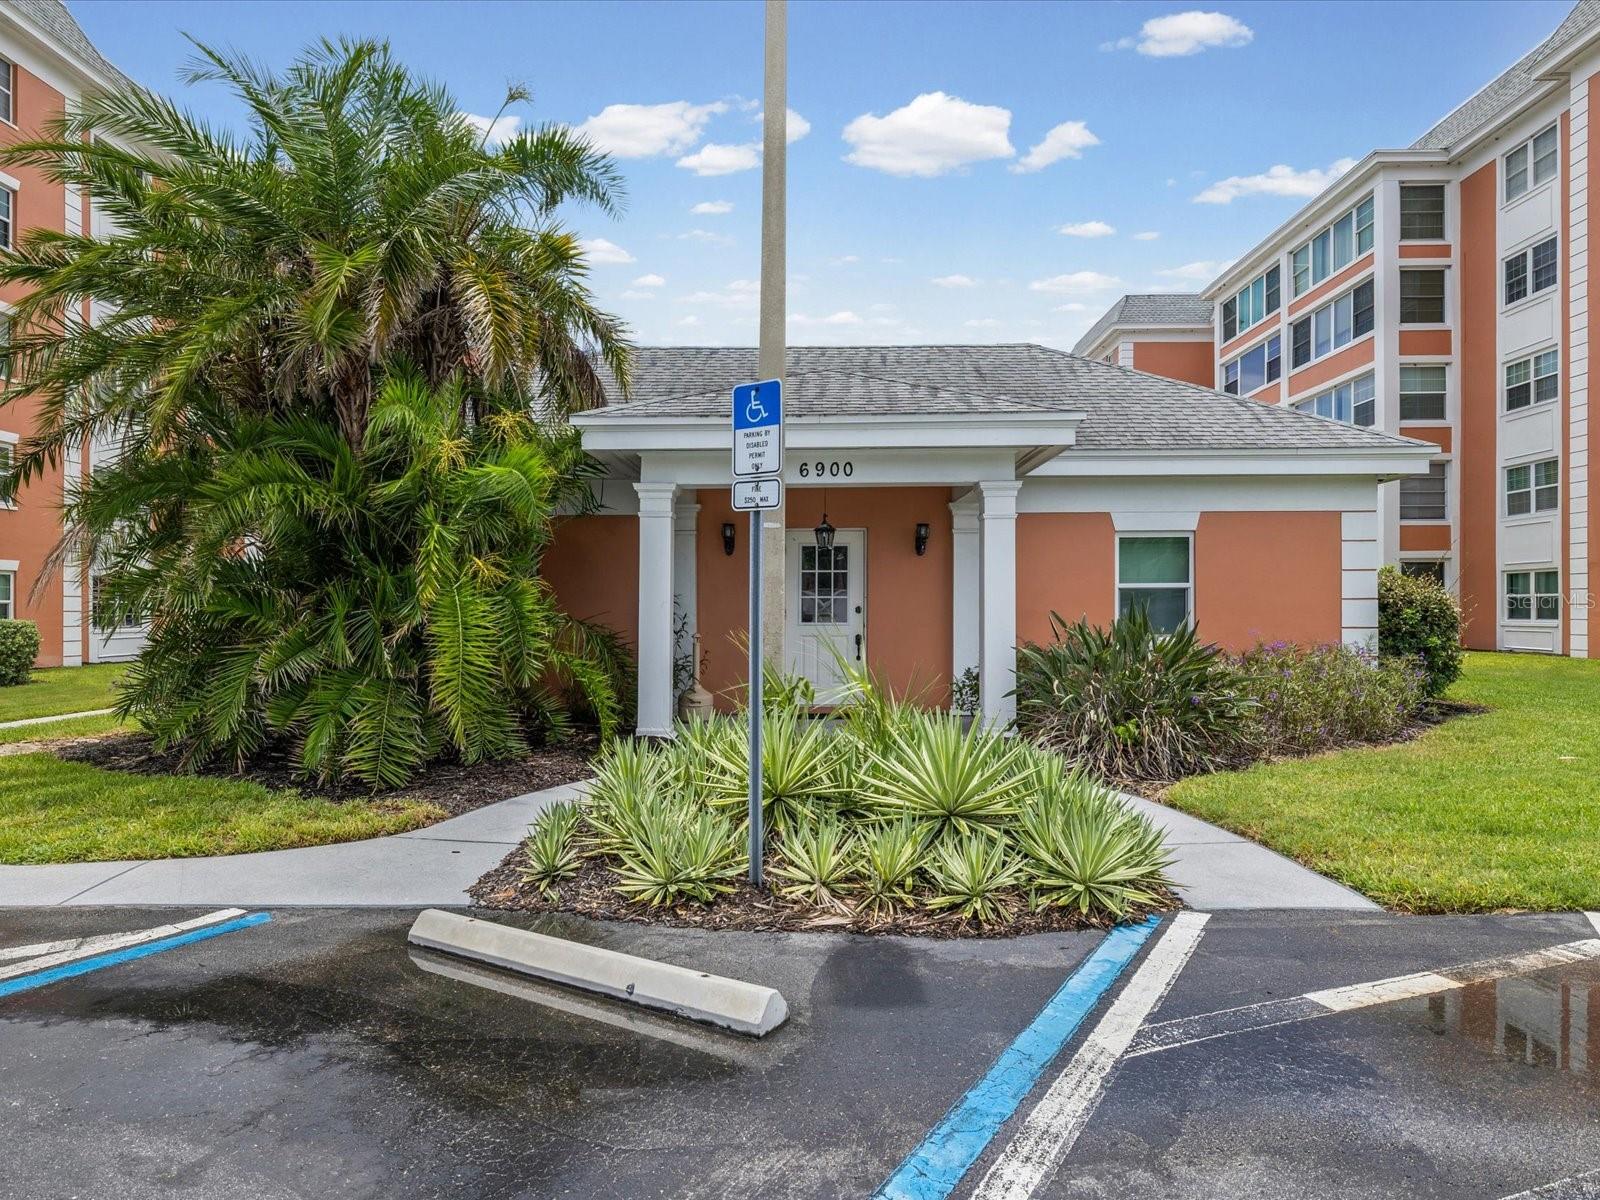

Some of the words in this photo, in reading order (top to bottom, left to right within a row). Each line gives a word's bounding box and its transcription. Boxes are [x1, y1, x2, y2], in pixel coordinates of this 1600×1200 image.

[746, 441, 769, 449] DISABLED
[748, 451, 765, 459] PERMIT
[799, 462, 853, 478] 6900
[744, 496, 756, 504] $250
